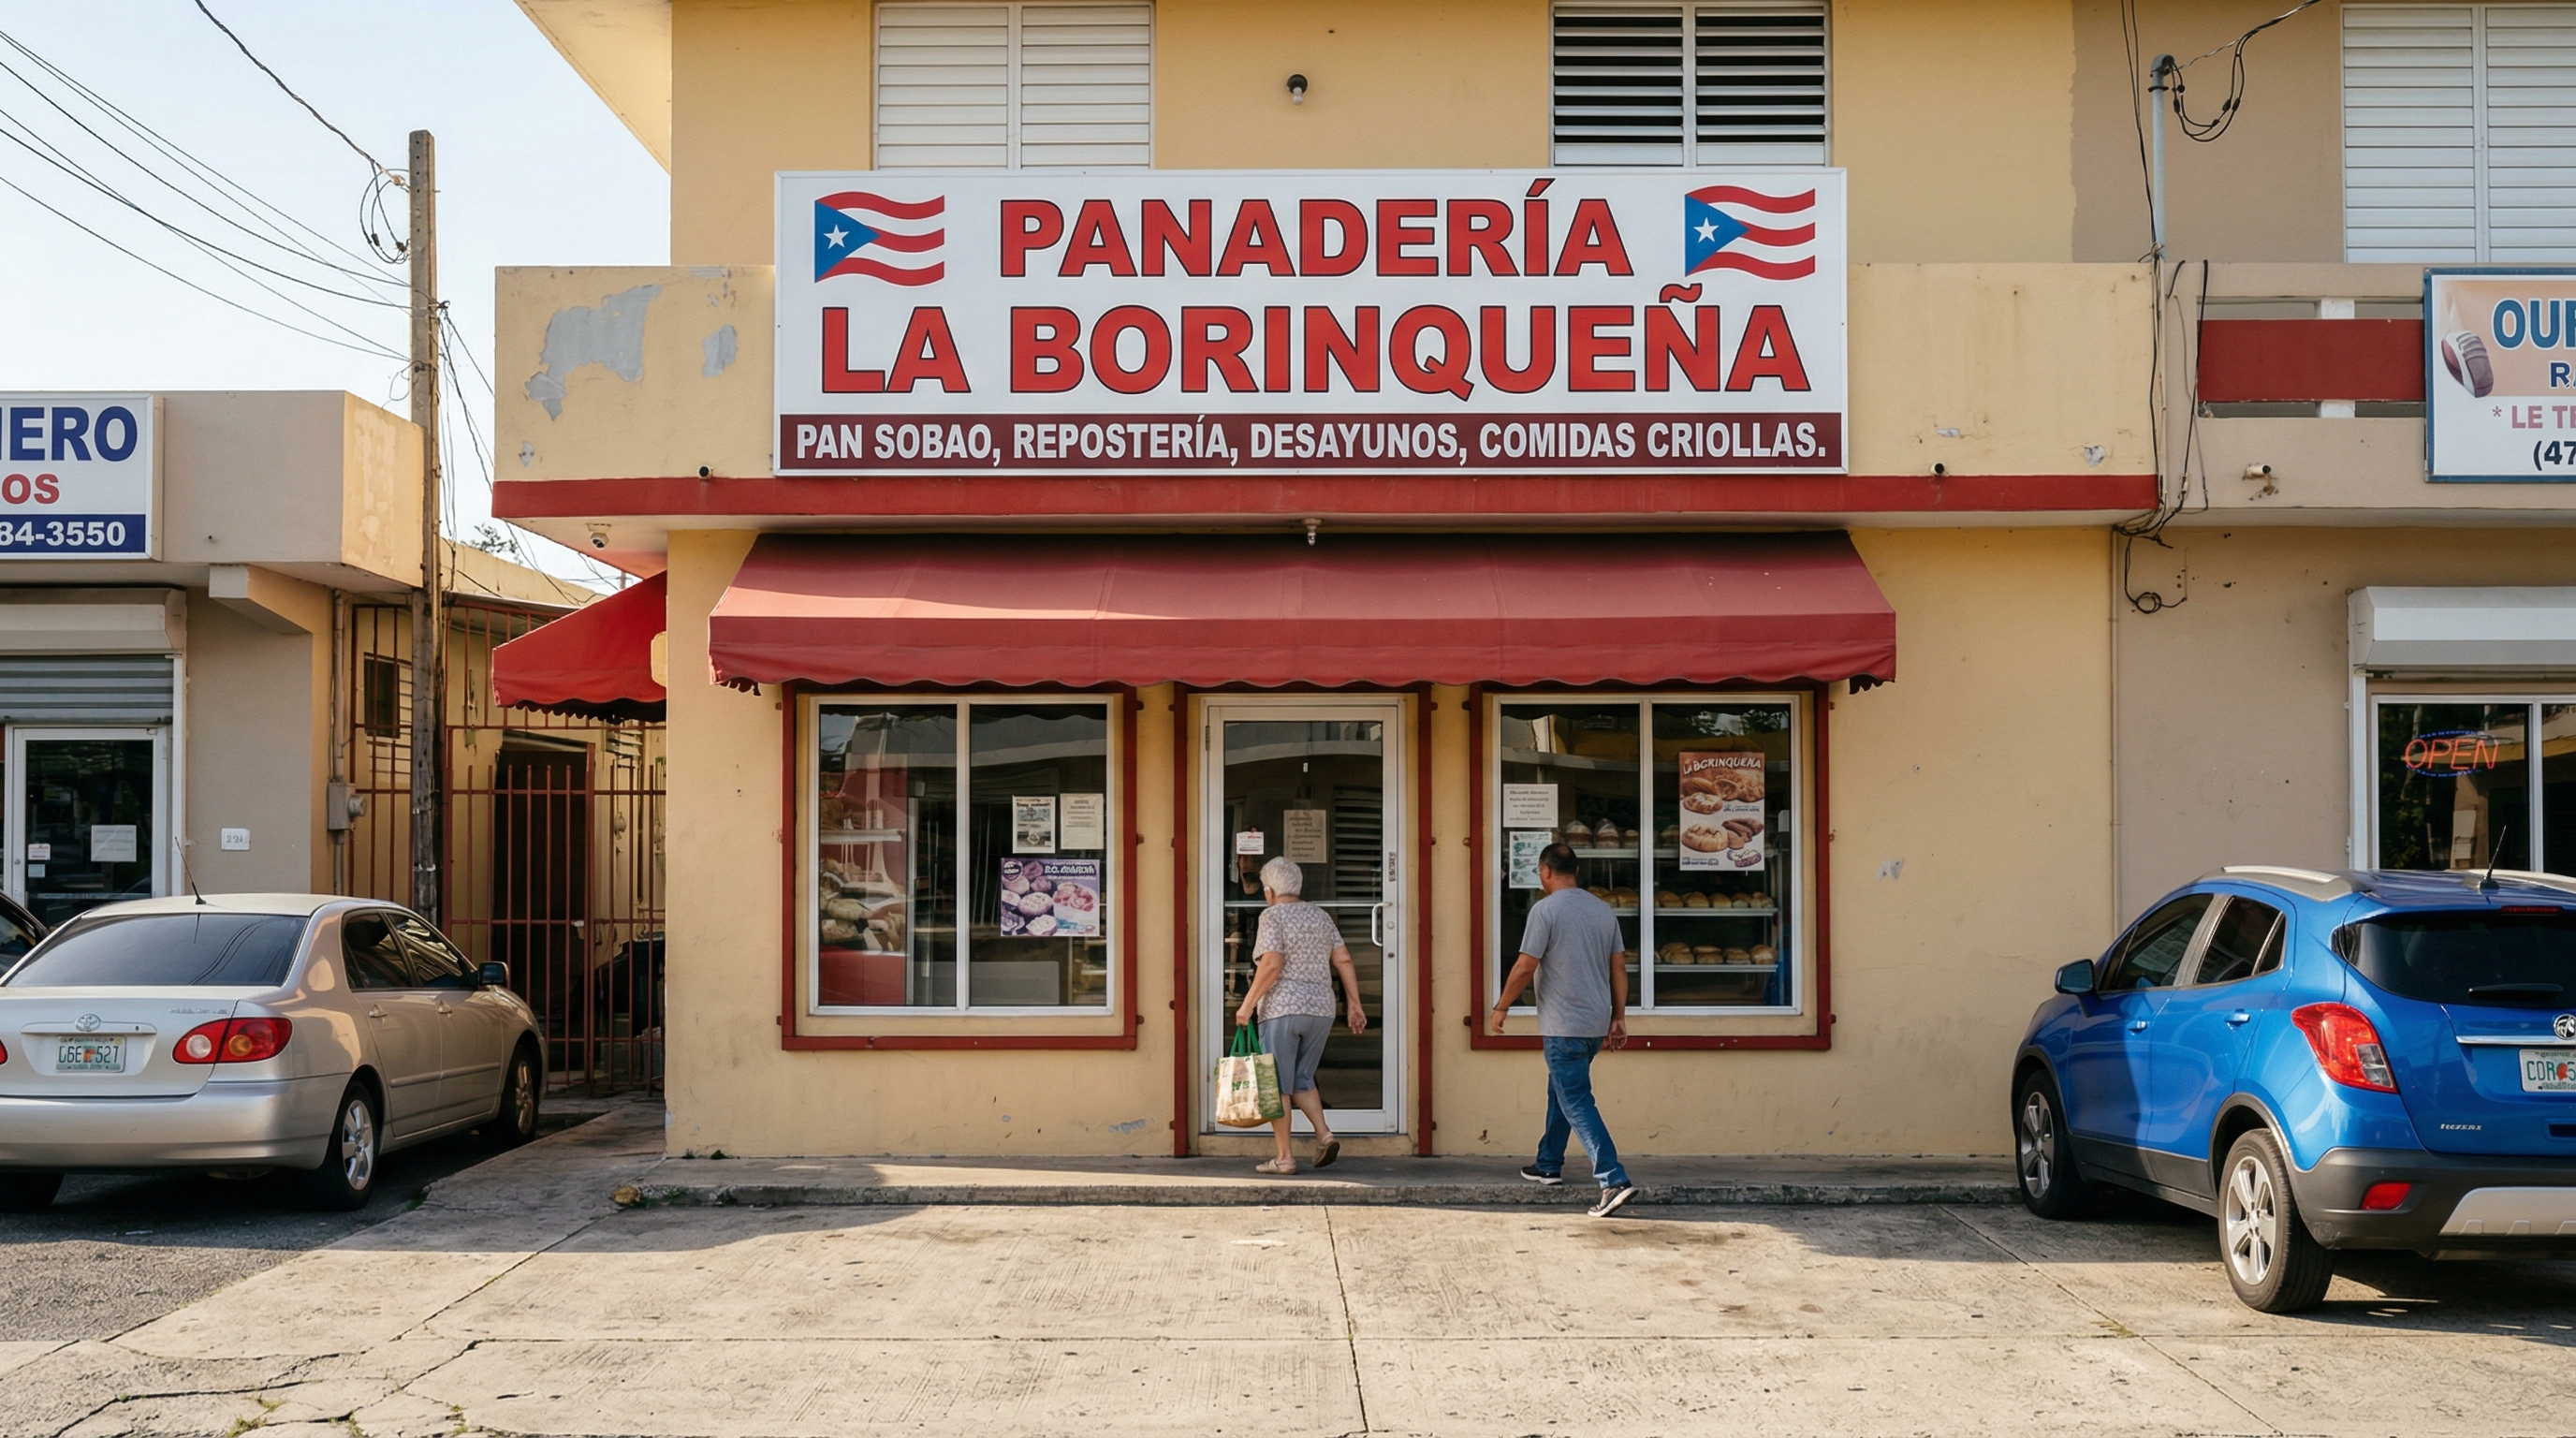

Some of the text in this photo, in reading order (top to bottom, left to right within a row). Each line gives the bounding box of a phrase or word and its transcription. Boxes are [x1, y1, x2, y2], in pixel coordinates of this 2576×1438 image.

[1001, 178, 1634, 277] PANADERÍA
[822, 283, 1811, 402] LA BORINQUEÑA
[2550, 362, 2576, 388] R
[0, 406, 138, 462] ERO
[2511, 405, 2543, 429] LE
[797, 415, 1826, 467] PAN SOBAO, REPOSTERÍA, DESAYUNOS, COMIDAS CRIOLLAS.
[2405, 739, 2499, 770] OPEN
[95, 1045, 119, 1064] 527
